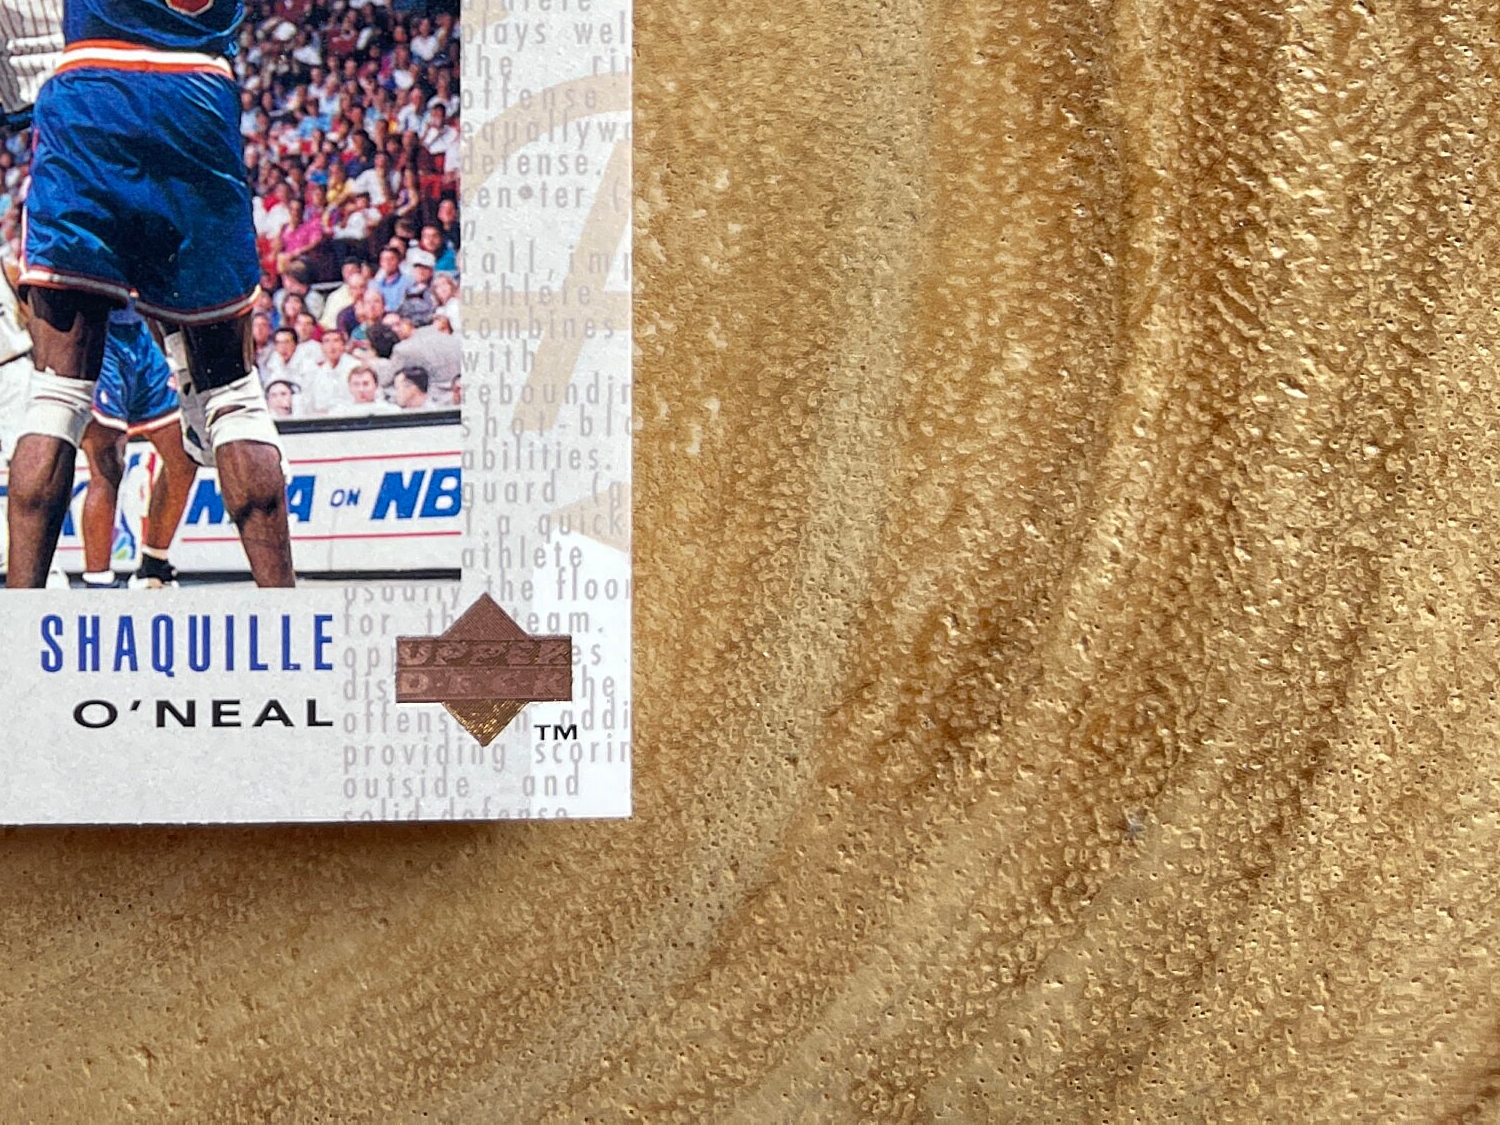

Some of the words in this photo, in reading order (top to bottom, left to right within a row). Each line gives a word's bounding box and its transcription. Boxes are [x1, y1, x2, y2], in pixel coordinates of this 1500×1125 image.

[462, 338, 536, 373] with
[40, 613, 334, 678] SHAQUILLE
[73, 697, 335, 729] O'NEAL
[533, 724, 578, 741] TM
[343, 763, 470, 799] outside
